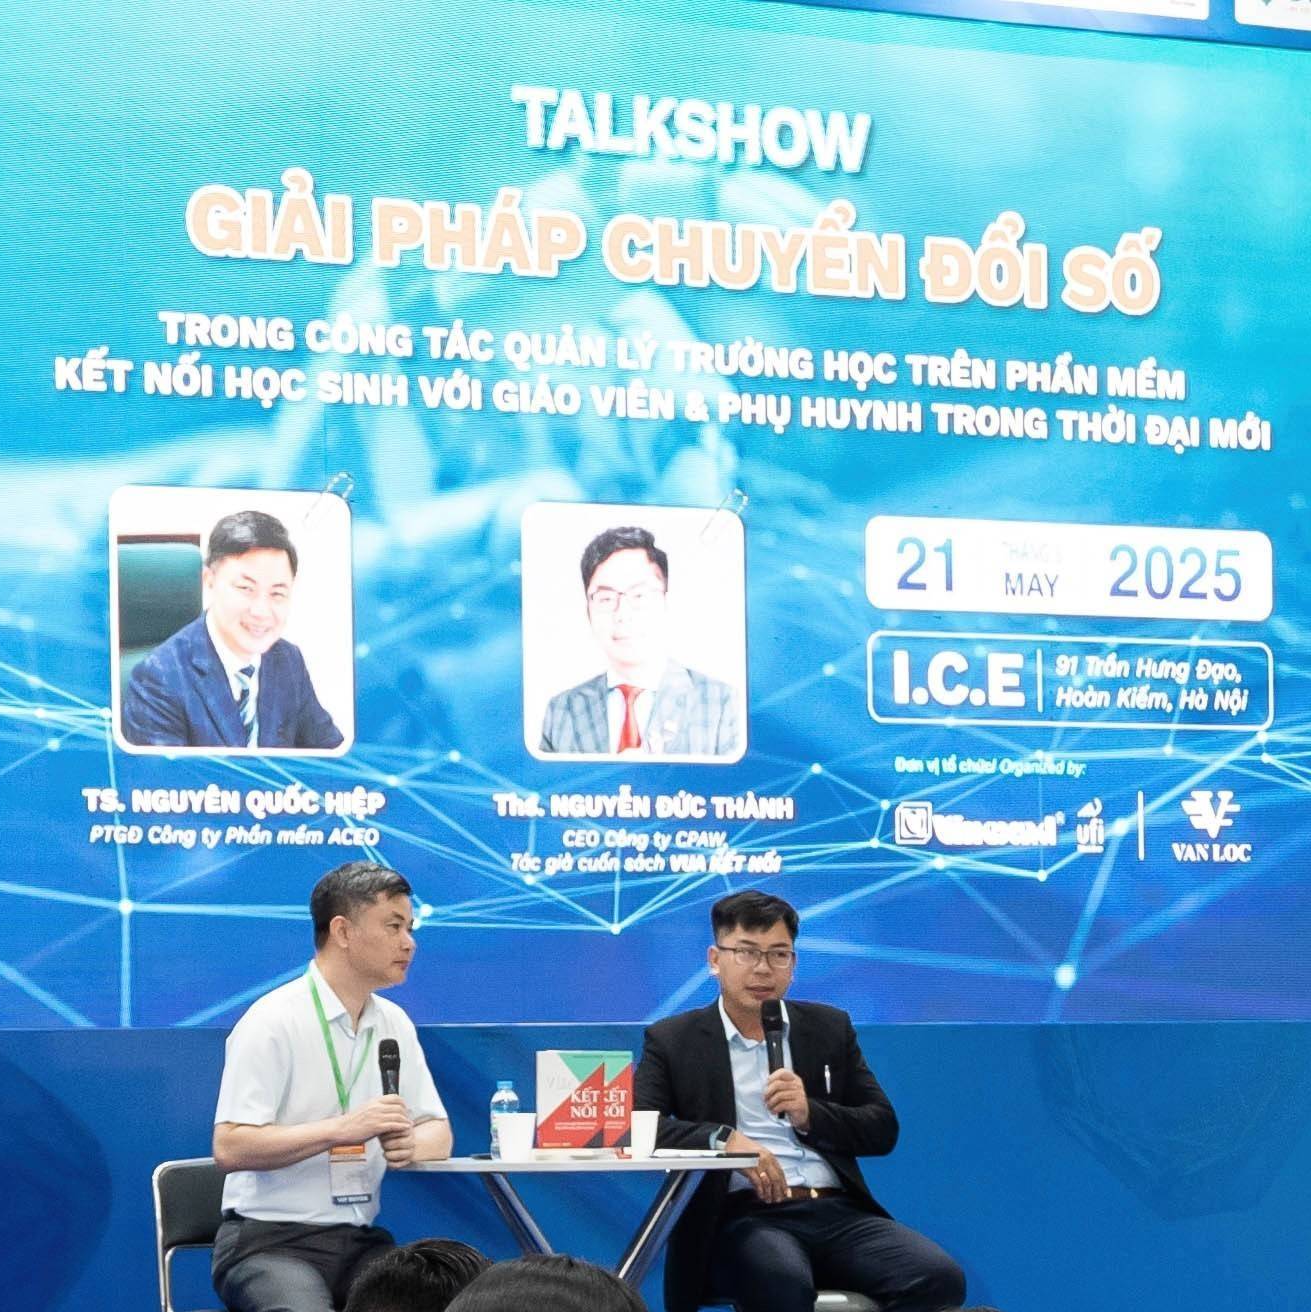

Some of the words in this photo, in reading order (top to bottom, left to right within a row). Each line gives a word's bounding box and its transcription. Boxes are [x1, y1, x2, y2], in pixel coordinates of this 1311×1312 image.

[510, 84, 872, 173] TALKSHOW
[186, 168, 355, 265] GIẢI
[372, 187, 587, 278] PHÁP
[603, 198, 906, 299] CHUYỂN
[919, 211, 1048, 310] ĐỔI
[1062, 226, 1163, 315] SỐ
[158, 311, 294, 351] TRONG
[305, 314, 413, 357] CÔNG
[422, 319, 494, 361] TÁC
[824, 349, 897, 391] HỌC
[905, 348, 996, 389] TRÊN
[54, 346, 133, 395] KẾT
[143, 351, 212, 397] NỐI
[225, 366, 306, 408] HỌC
[317, 371, 408, 406] SINH
[417, 369, 482, 411] VỚI
[493, 375, 579, 415] GIÁO
[588, 377, 675, 420] VIÊN
[685, 390, 709, 422] &
[719, 392, 791, 435] PHỤ
[801, 396, 922, 433] HUYNH
[931, 403, 1048, 440] TRONG
[1210, 411, 1272, 451] MỚI
[896, 536, 954, 592] 21
[1109, 543, 1242, 602] 2025
[1005, 572, 1059, 598] MAY
[893, 649, 1026, 706] I.C.E
[1055, 654, 1078, 677] 91
[1179, 687, 1208, 710] Hà
[1214, 688, 1249, 716] Nội
[82, 788, 126, 812] TS.
[245, 782, 320, 820] QUỐC
[550, 785, 651, 818] NGUYỄN
[201, 826, 222, 849] ty
[562, 830, 600, 848] CEO
[652, 832, 673, 852] ty
[570, 1102, 598, 1118] NỐI
[571, 1086, 600, 1103] KẾT
